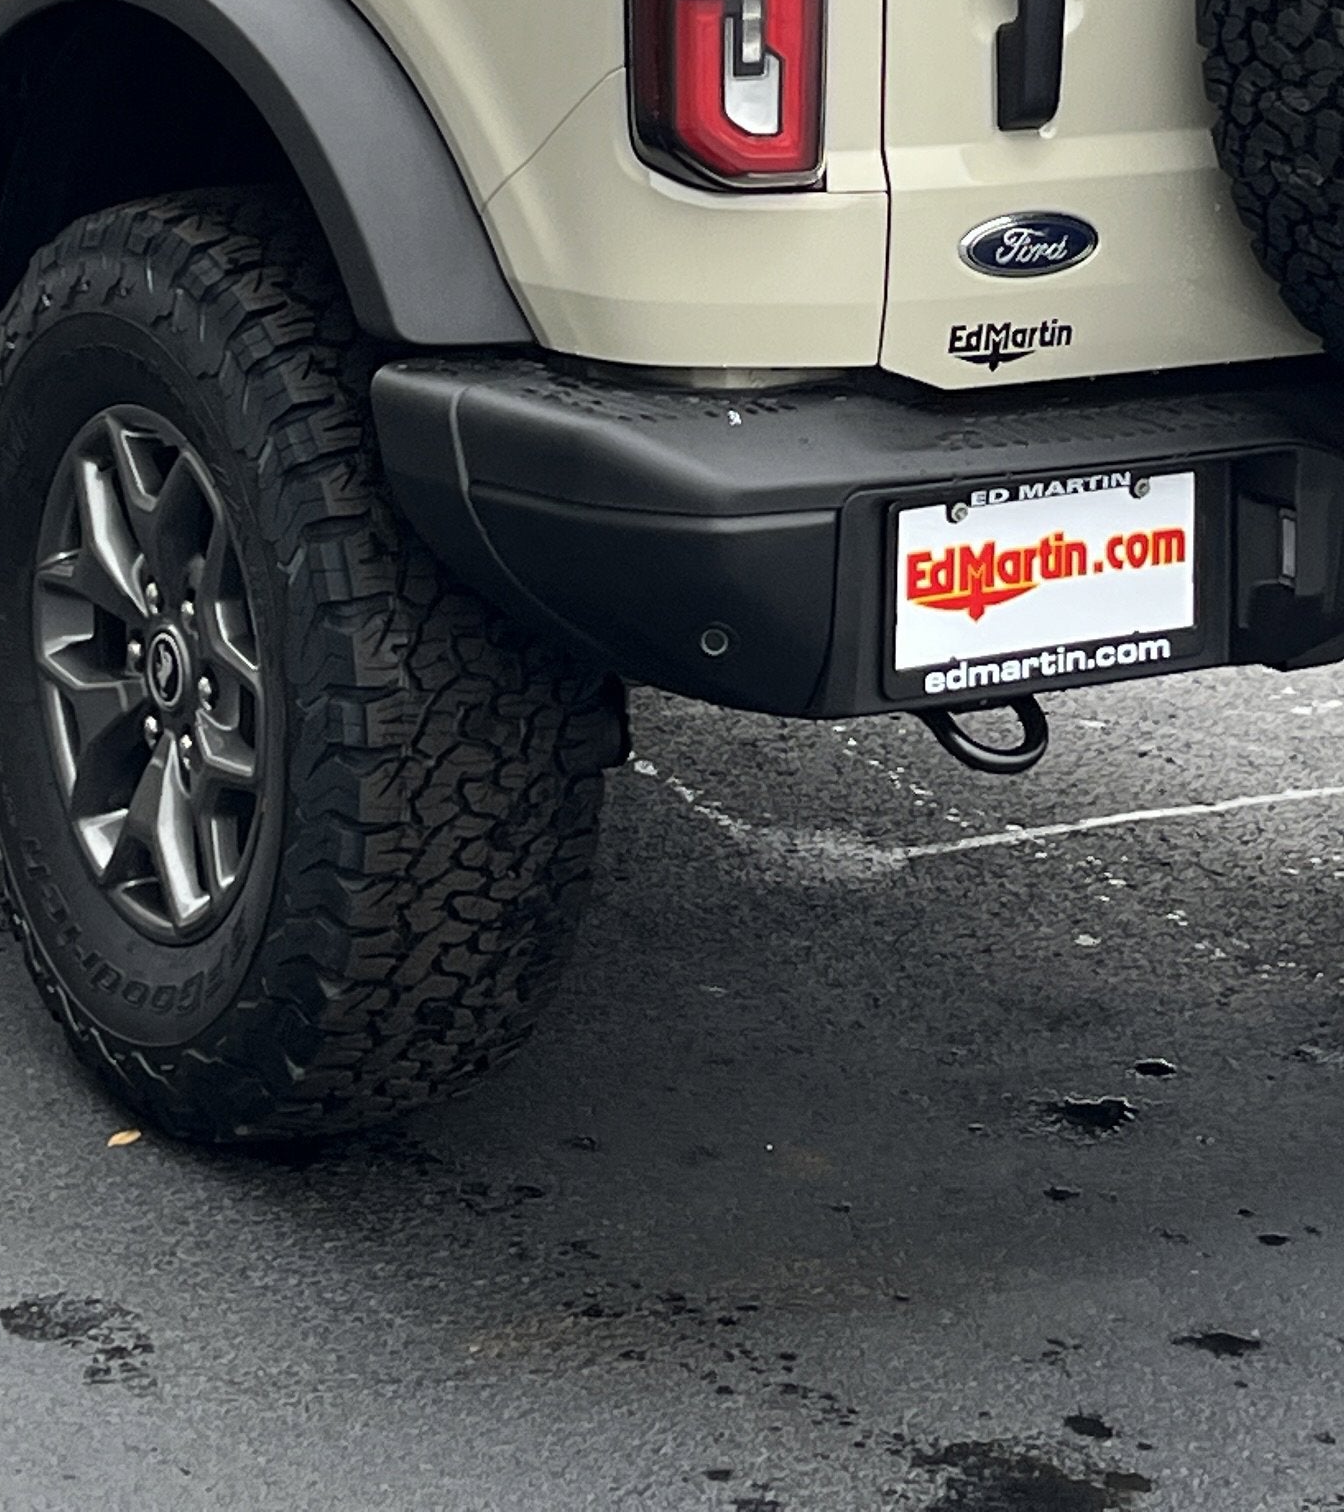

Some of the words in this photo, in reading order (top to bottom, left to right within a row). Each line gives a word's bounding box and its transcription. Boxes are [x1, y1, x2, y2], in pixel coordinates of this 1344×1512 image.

[995, 227, 1069, 266] Ford
[947, 318, 1074, 356] EdMartin
[970, 488, 1011, 507] ED
[1019, 471, 1132, 500] MARTIN
[923, 636, 1171, 695] edmartin.com
